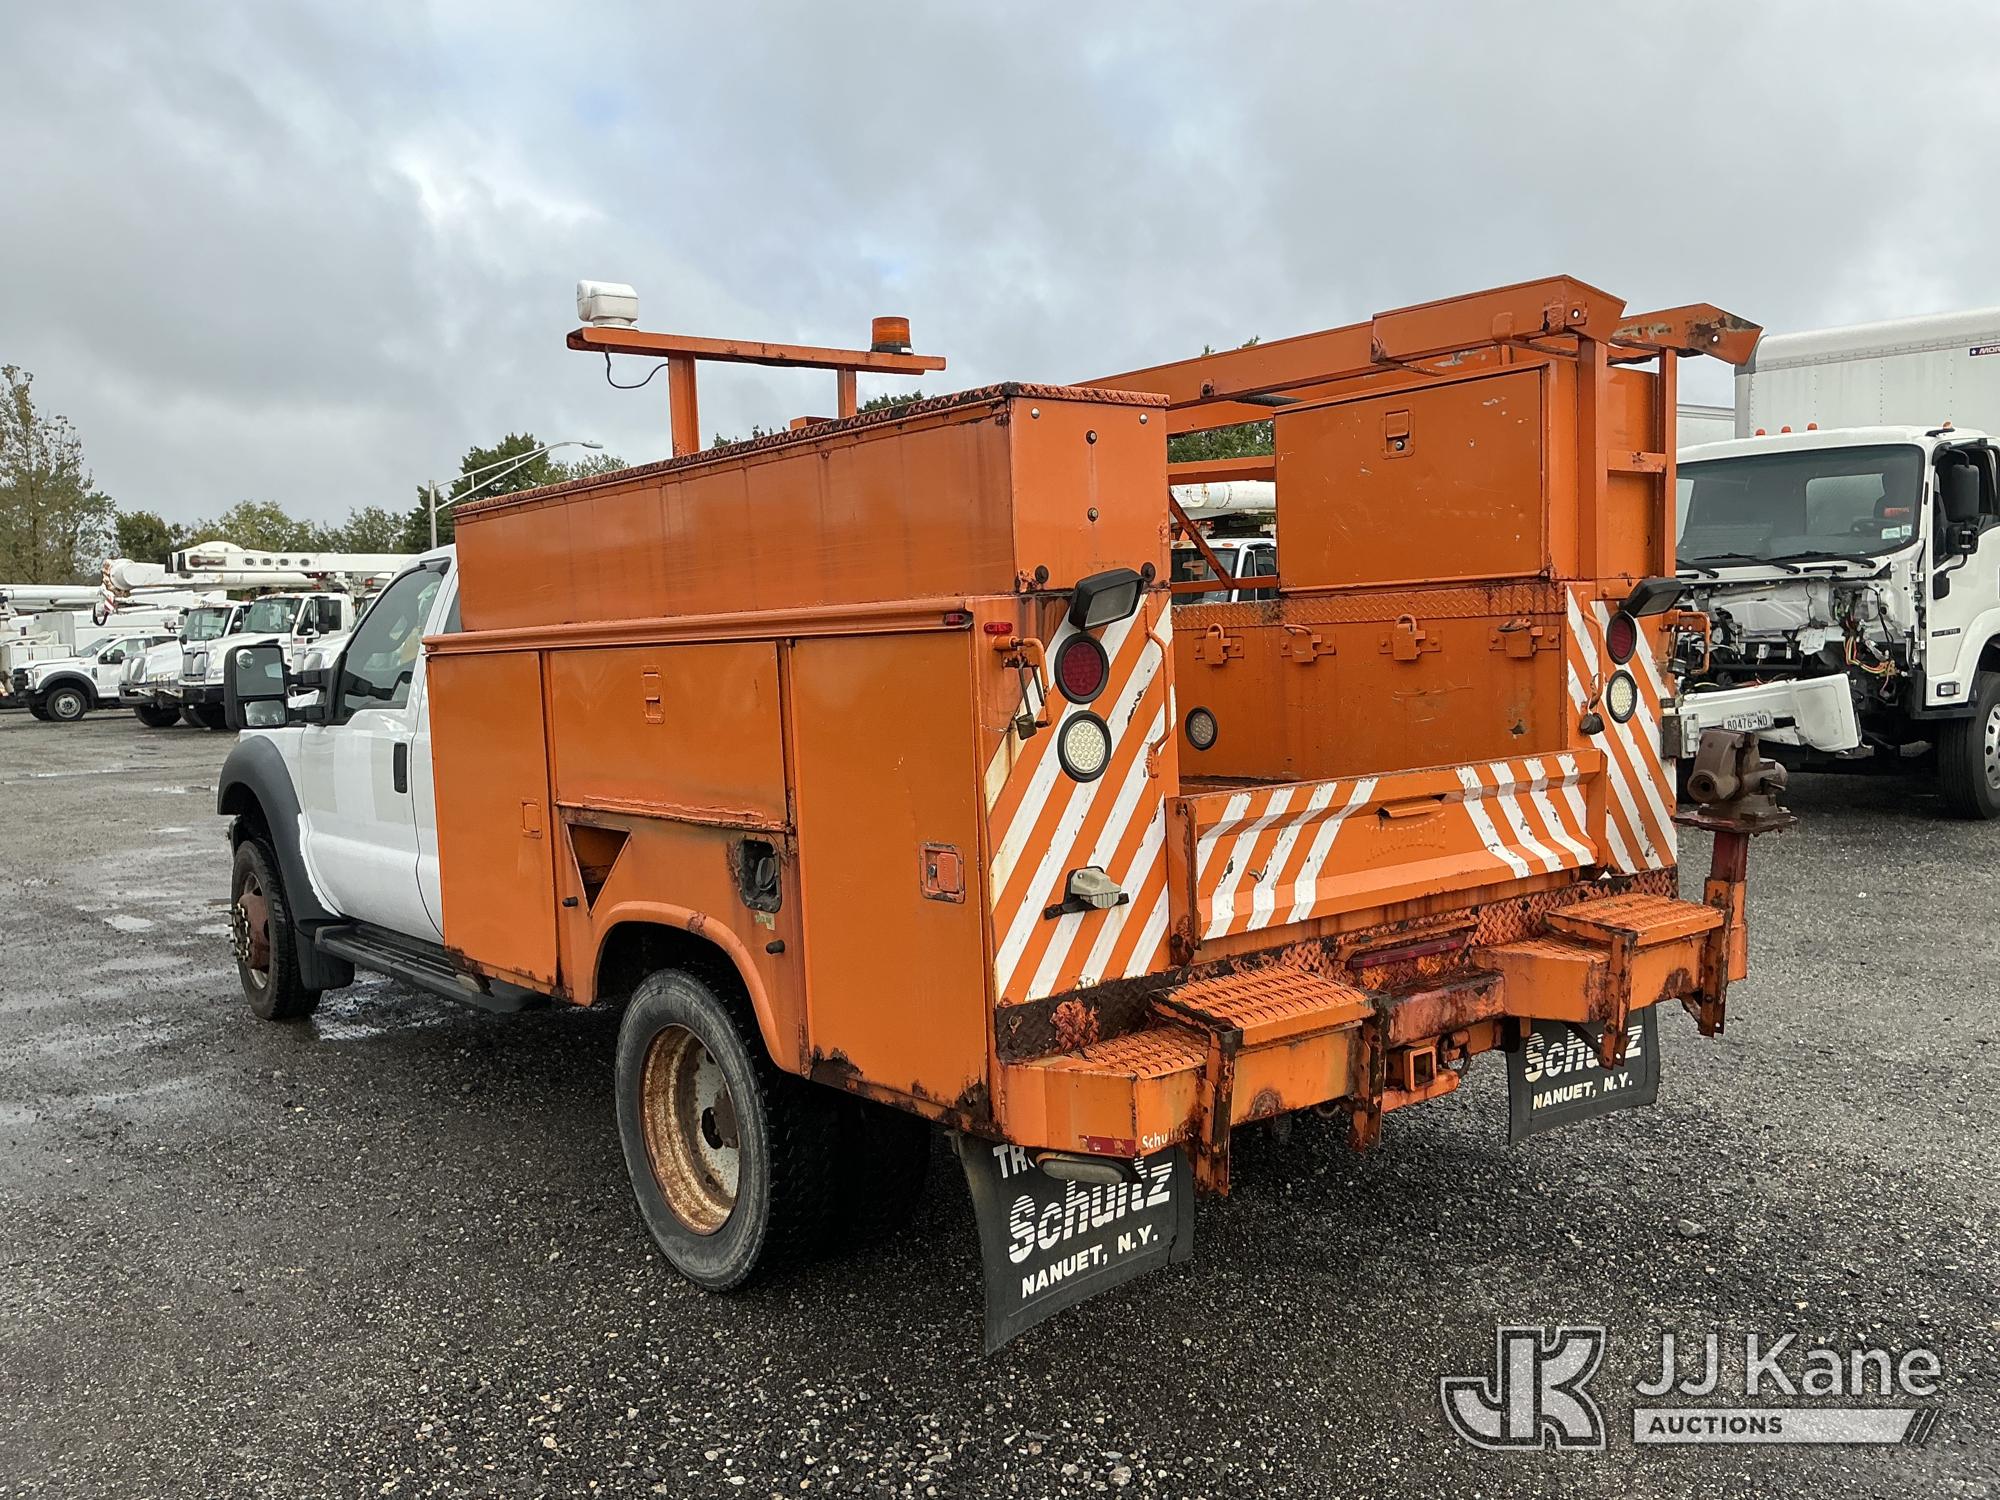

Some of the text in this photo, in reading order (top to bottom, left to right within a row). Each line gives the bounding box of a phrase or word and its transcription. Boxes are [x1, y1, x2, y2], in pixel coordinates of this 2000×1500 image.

[1533, 1072, 1632, 1110] NANUET, N.Y.
[1022, 1224, 1158, 1299] NANUET, N.Y.
